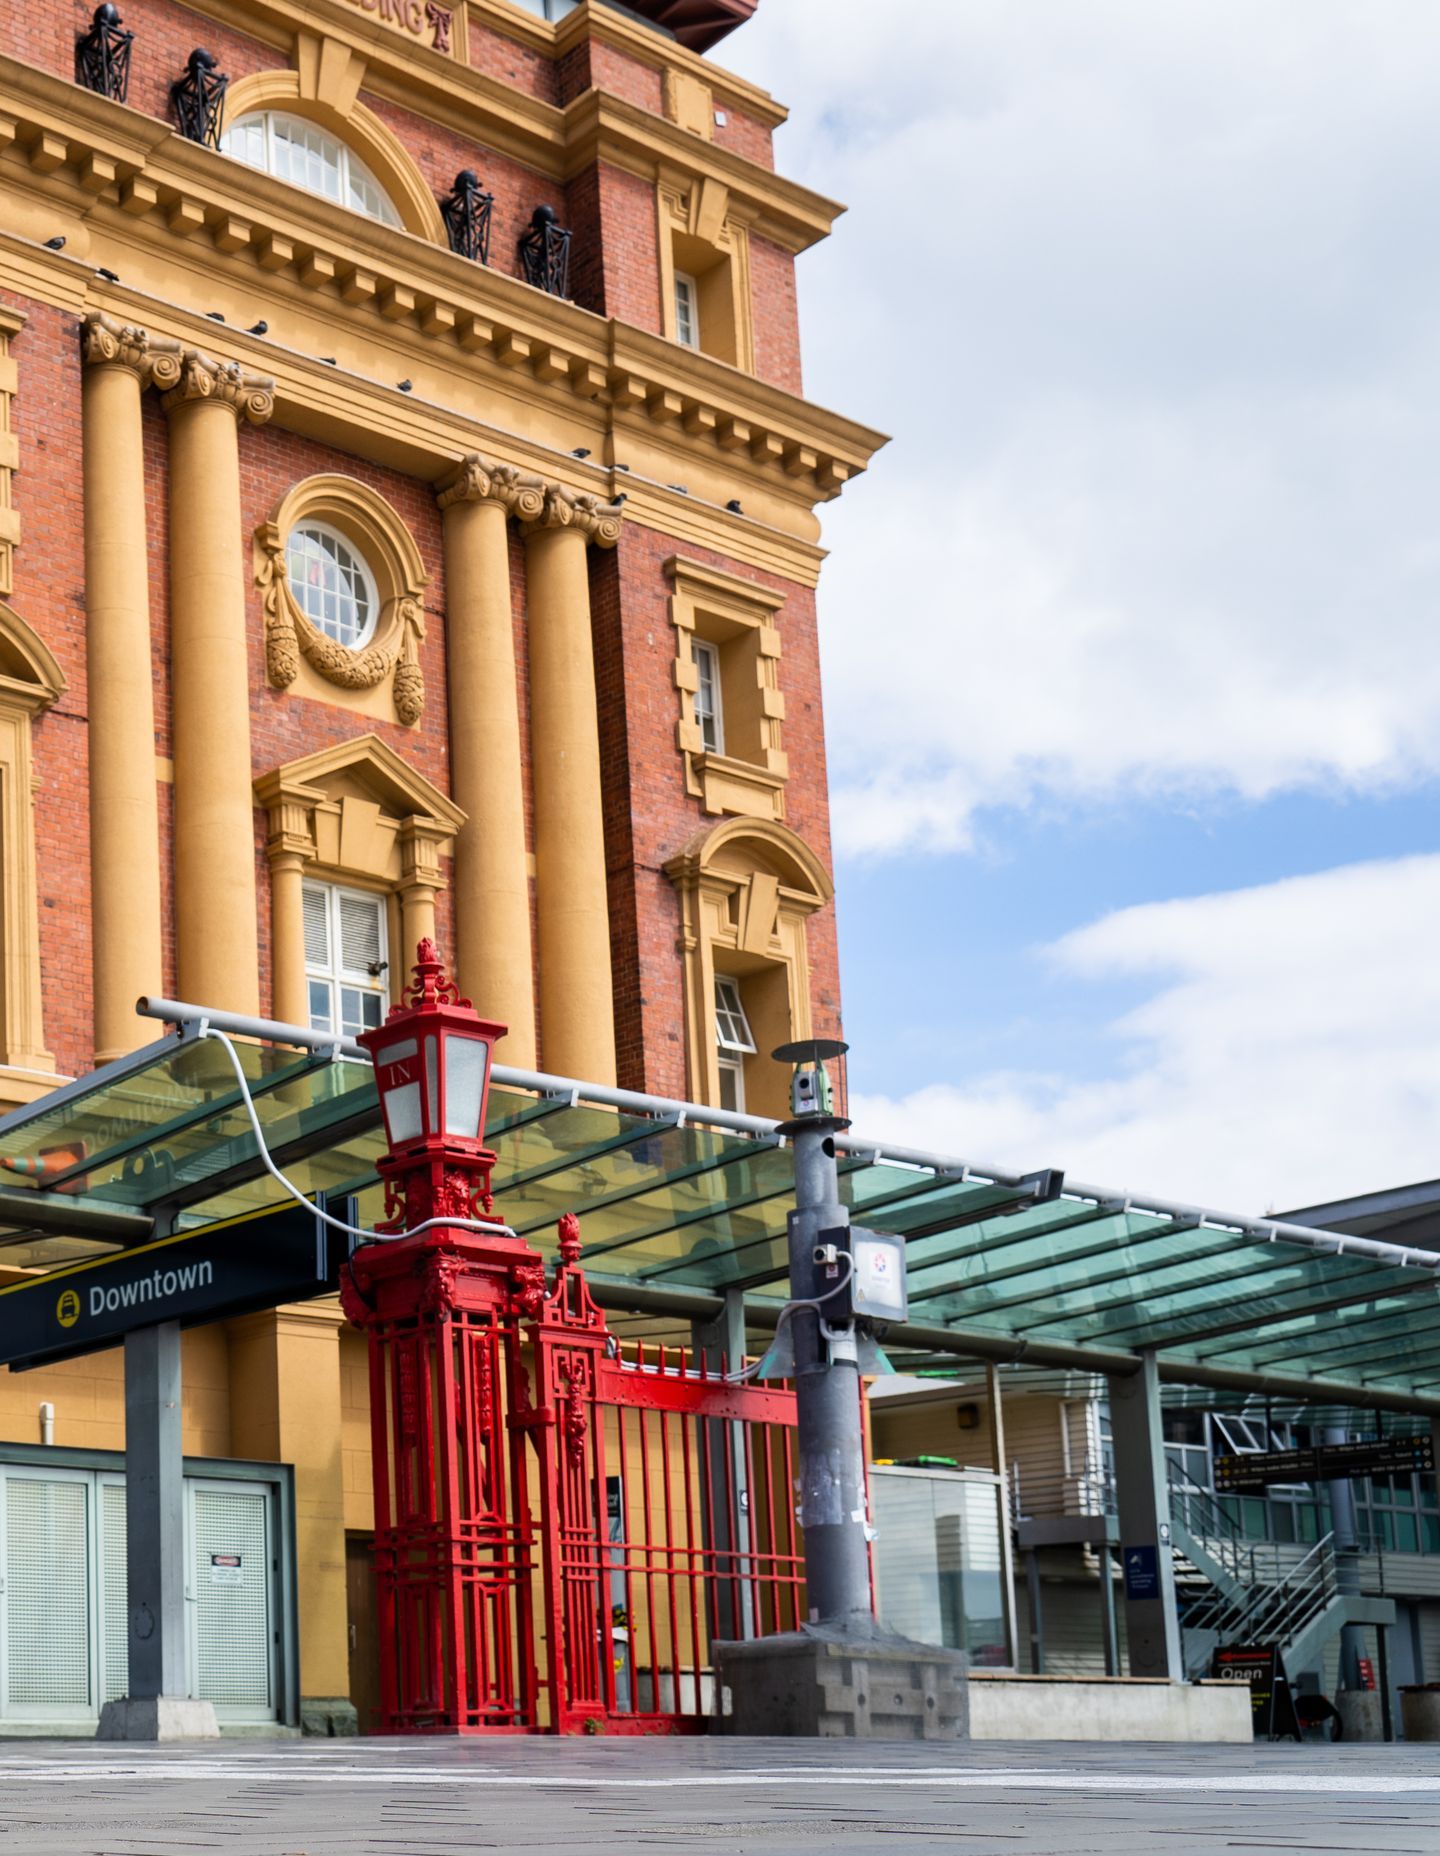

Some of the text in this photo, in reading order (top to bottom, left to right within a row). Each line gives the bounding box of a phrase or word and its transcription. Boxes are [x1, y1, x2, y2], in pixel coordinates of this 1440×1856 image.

[388, 1060, 411, 1086] IN
[90, 1260, 212, 1316] Downtown
[1221, 1667, 1262, 1680] Open
